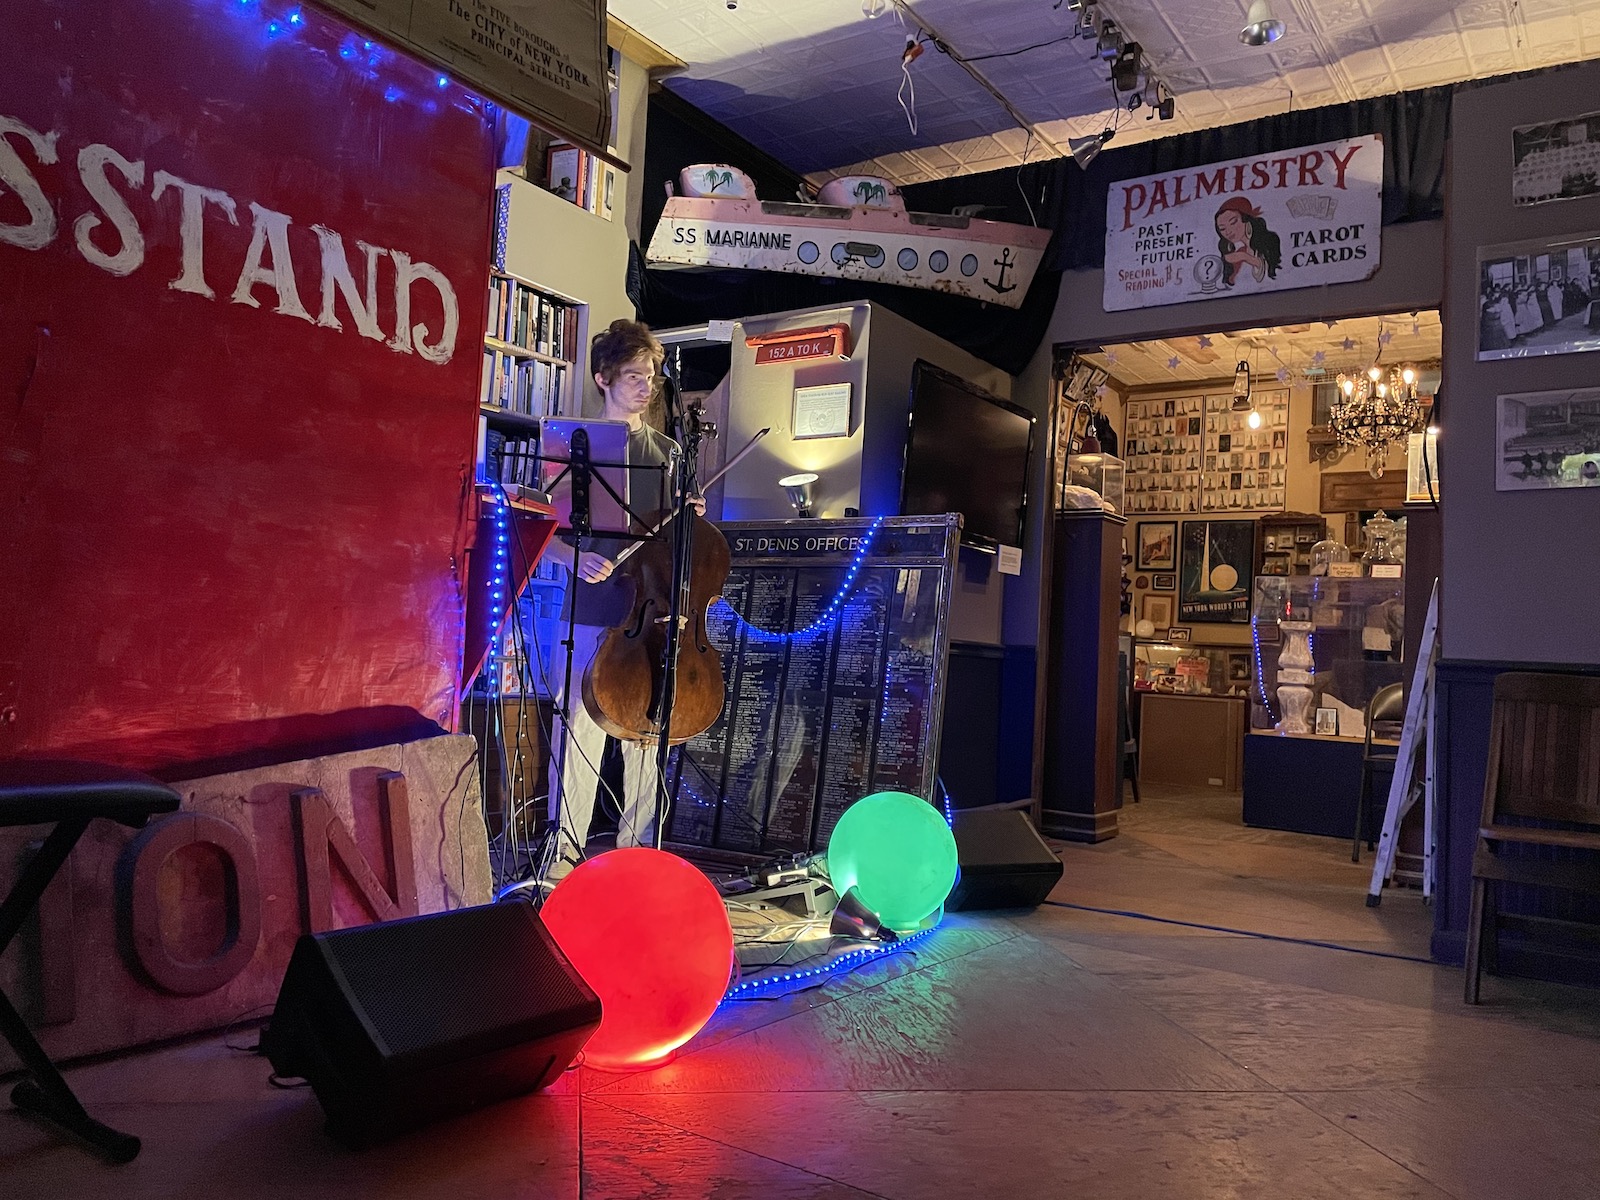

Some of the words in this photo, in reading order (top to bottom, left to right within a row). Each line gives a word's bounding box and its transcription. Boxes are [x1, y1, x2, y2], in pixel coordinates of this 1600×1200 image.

[490, 6, 511, 28] FIVE
[513, 21, 561, 56] BOROUGHS
[448, 0, 471, 22] The
[475, 13, 506, 40] CITY
[509, 37, 520, 48] of
[525, 42, 551, 67] NEW
[556, 60, 590, 87] YORK
[471, 28, 525, 66] PRINCIPAL
[530, 61, 571, 90] STREETS
[1120, 145, 1363, 232] PALMISTRY
[673, 227, 697, 245] SS
[704, 229, 792, 250] MARIANNE
[1290, 224, 1365, 248] TAROT
[1291, 245, 1367, 268] CARDS
[769, 347, 786, 359] 152
[787, 345, 795, 357] A
[797, 344, 810, 355] TO
[812, 342, 821, 353] K
[757, 537, 800, 551] DENIS
[805, 537, 867, 551] OFFICES
[1182, 605, 1194, 613] NEW
[1194, 604, 1208, 612] YORK
